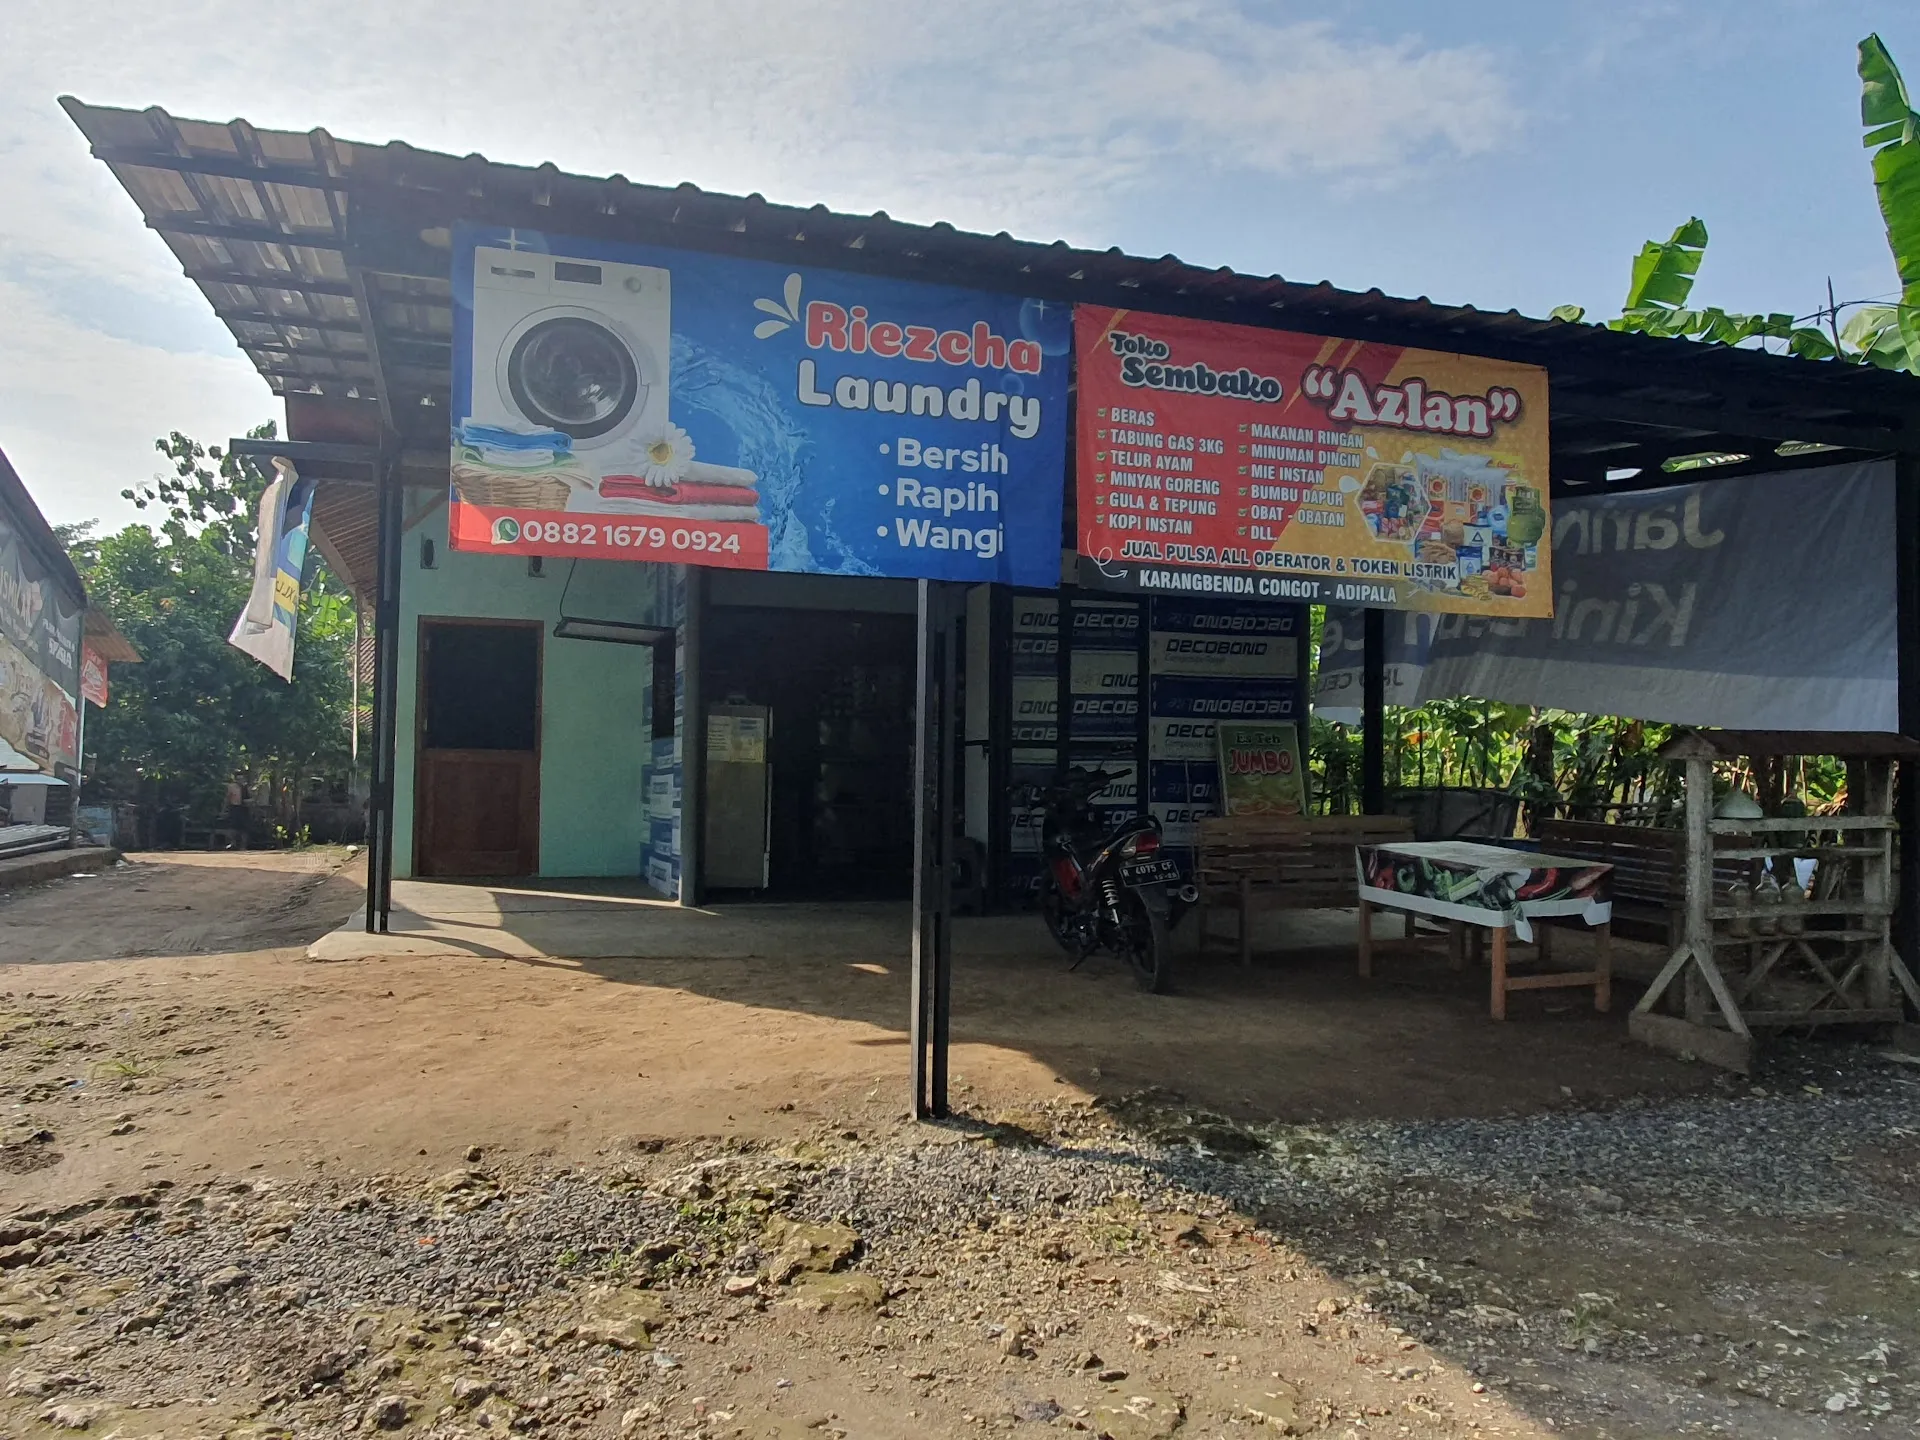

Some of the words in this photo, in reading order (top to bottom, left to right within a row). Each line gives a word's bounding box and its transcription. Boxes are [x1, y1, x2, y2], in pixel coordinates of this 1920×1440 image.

[806, 300, 1042, 374] Riezcha
[1108, 331, 1171, 361] Toko
[1120, 356, 1283, 403] Sembako
[798, 360, 1041, 439] Laundry
[1111, 407, 1155, 426] BERAS
[1110, 429, 1163, 448] TABUNG
[1168, 435, 1194, 451] GAS
[1199, 438, 1224, 454] 3KG
[1251, 424, 1313, 442] MAKANAN
[1318, 430, 1364, 448] RINGAN
[897, 437, 1009, 475] Bersih
[1110, 450, 1151, 467] TELUR
[1156, 456, 1193, 471] AYAM
[1251, 444, 1313, 463] MINUMAN
[1319, 450, 1361, 468] DINGIN
[1110, 470, 1161, 490] MINYAK
[1166, 477, 1220, 495] GORENG
[1251, 464, 1275, 479] MIE
[1280, 467, 1324, 484] INSTAN
[896, 481, 999, 514] Rapih
[1109, 492, 1144, 509] GULA
[1149, 496, 1159, 511] &
[1164, 497, 1217, 515] TEPUNG
[1251, 484, 1298, 502] BUMBU
[1303, 489, 1343, 506] DAPUR
[1109, 513, 1141, 529] KOPI
[1146, 517, 1192, 535] INSTAN
[1251, 504, 1284, 520] OBAT
[1298, 509, 1344, 526] OBATAN
[523, 520, 597, 546] 0882
[602, 525, 666, 549] 1679
[674, 528, 740, 554] 0924
[896, 518, 1004, 559] Wangi
[1121, 540, 1162, 558] JUAL
[1166, 544, 1216, 563] PULSA
[1220, 548, 1250, 566] ALL
[1254, 550, 1331, 572] OPERATOR
[1336, 557, 1346, 572] &
[1350, 558, 1399, 575] TOKEN
[1404, 563, 1457, 580] LISTRIK
[1139, 570, 1254, 594] KARANGBENDA
[1259, 578, 1320, 598] CONGOT
[1336, 583, 1397, 603] ADIPALA
[1228, 748, 1294, 775] JUMBO
